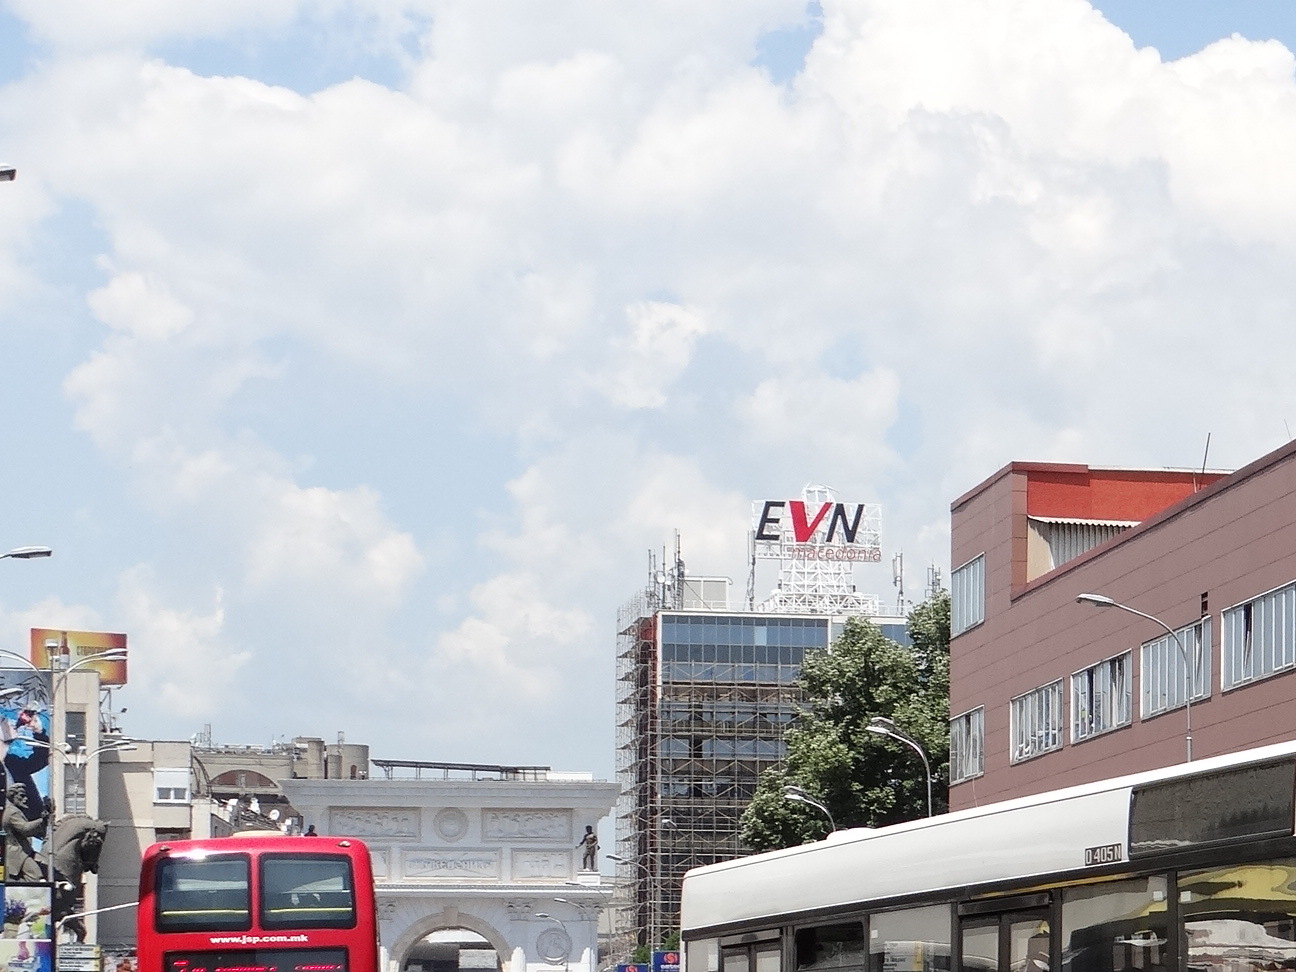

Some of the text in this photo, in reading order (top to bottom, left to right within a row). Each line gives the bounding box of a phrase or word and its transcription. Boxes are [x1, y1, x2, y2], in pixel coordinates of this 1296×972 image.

[755, 500, 865, 543] EVN
[792, 547, 882, 562] macedonia
[210, 934, 309, 945] www.jsp.com.mk
